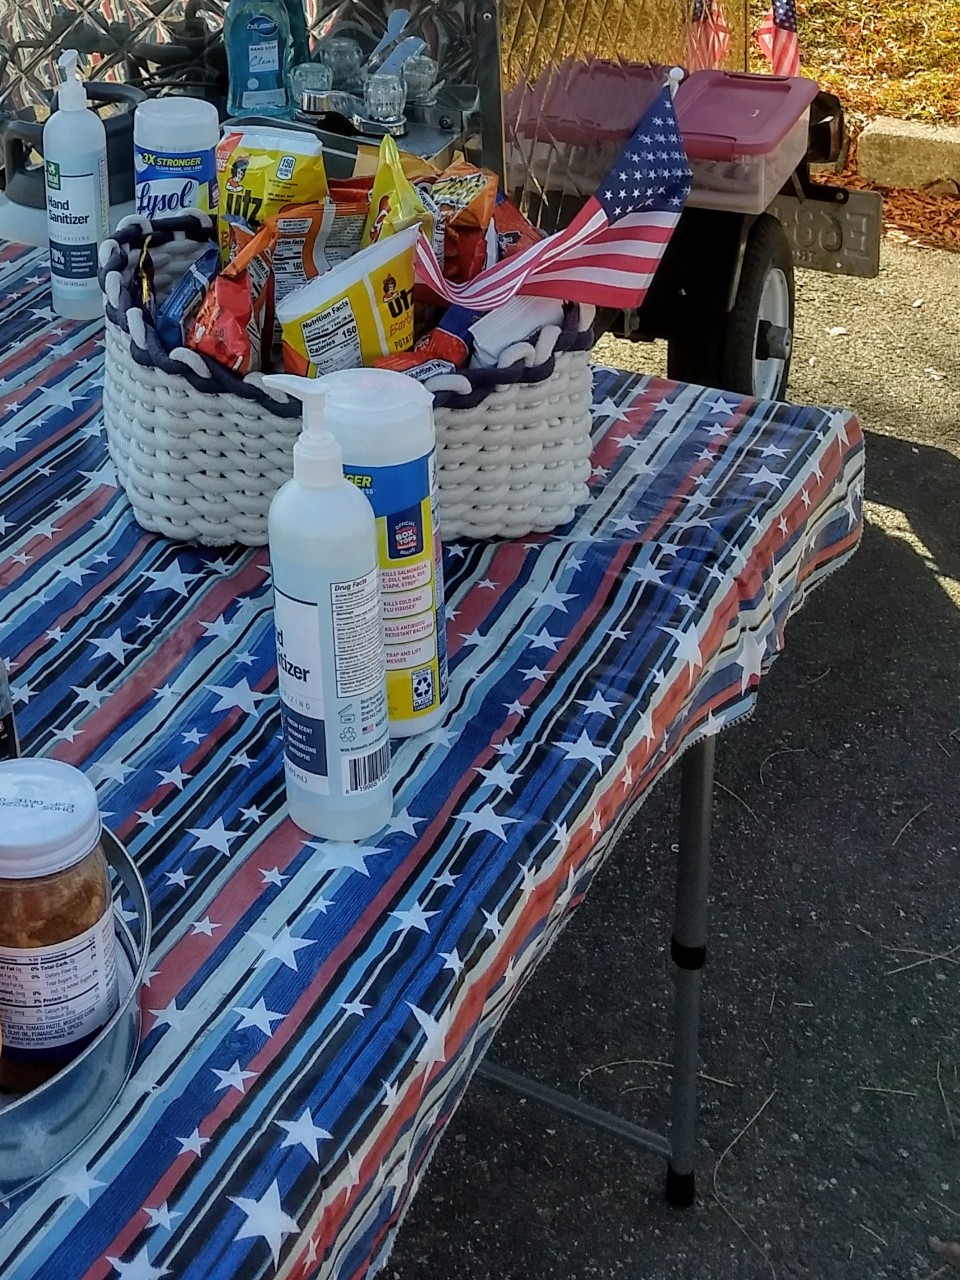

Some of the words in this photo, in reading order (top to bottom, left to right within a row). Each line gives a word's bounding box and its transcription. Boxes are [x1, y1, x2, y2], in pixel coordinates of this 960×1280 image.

[250, 55, 276, 67] Clear
[142, 152, 157, 166] 3X
[156, 157, 202, 167] STRONGER
[281, 158, 294, 169] 150
[47, 195, 70, 211] Hand
[48, 209, 90, 225] Sanitizer
[302, 311, 332, 330] Nutrition
[331, 299, 349, 315] Facts
[308, 339, 337, 355] Calories
[341, 325, 358, 340] 150
[395, 529, 414, 541] BOX
[398, 535, 417, 545] TOPS
[334, 583, 352, 592] Drug
[383, 599, 398, 607] KILLS
[398, 598, 412, 606] COLD
[412, 595, 422, 603] AND
[384, 628, 409, 638] RESISTANT
[410, 622, 433, 634] BACTERIA
[400, 619, 426, 631] ANTIBIOTIC
[385, 651, 400, 659] TRAP
[400, 649, 411, 657] AND
[411, 647, 422, 655] LIFT
[298, 723, 313, 735] SCENT
[43, 995, 62, 1003] Protein
[45, 1023, 63, 1031] PASTE,
[63, 1015, 84, 1027] MODIFIED
[53, 1027, 67, 1036] ACID,
